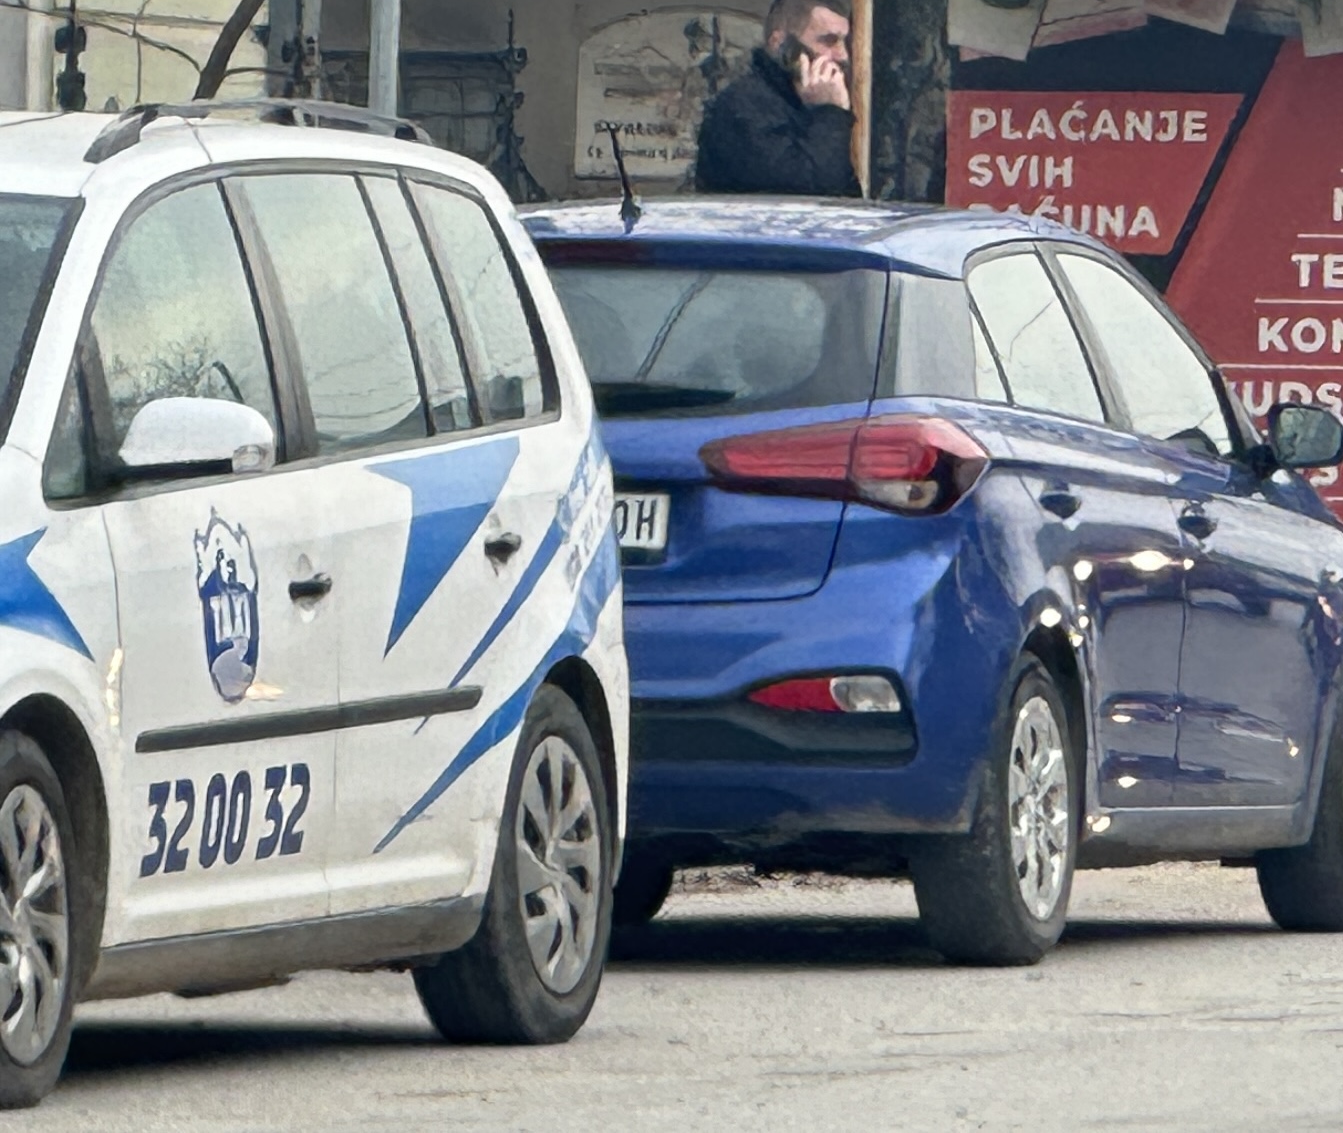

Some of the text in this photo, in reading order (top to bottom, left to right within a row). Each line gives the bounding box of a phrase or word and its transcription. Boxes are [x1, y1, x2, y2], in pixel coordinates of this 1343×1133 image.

[969, 100, 1209, 142] PLAĆANJE
[967, 154, 1074, 188] SVIH
[139, 762, 311, 878] 32 00 32
